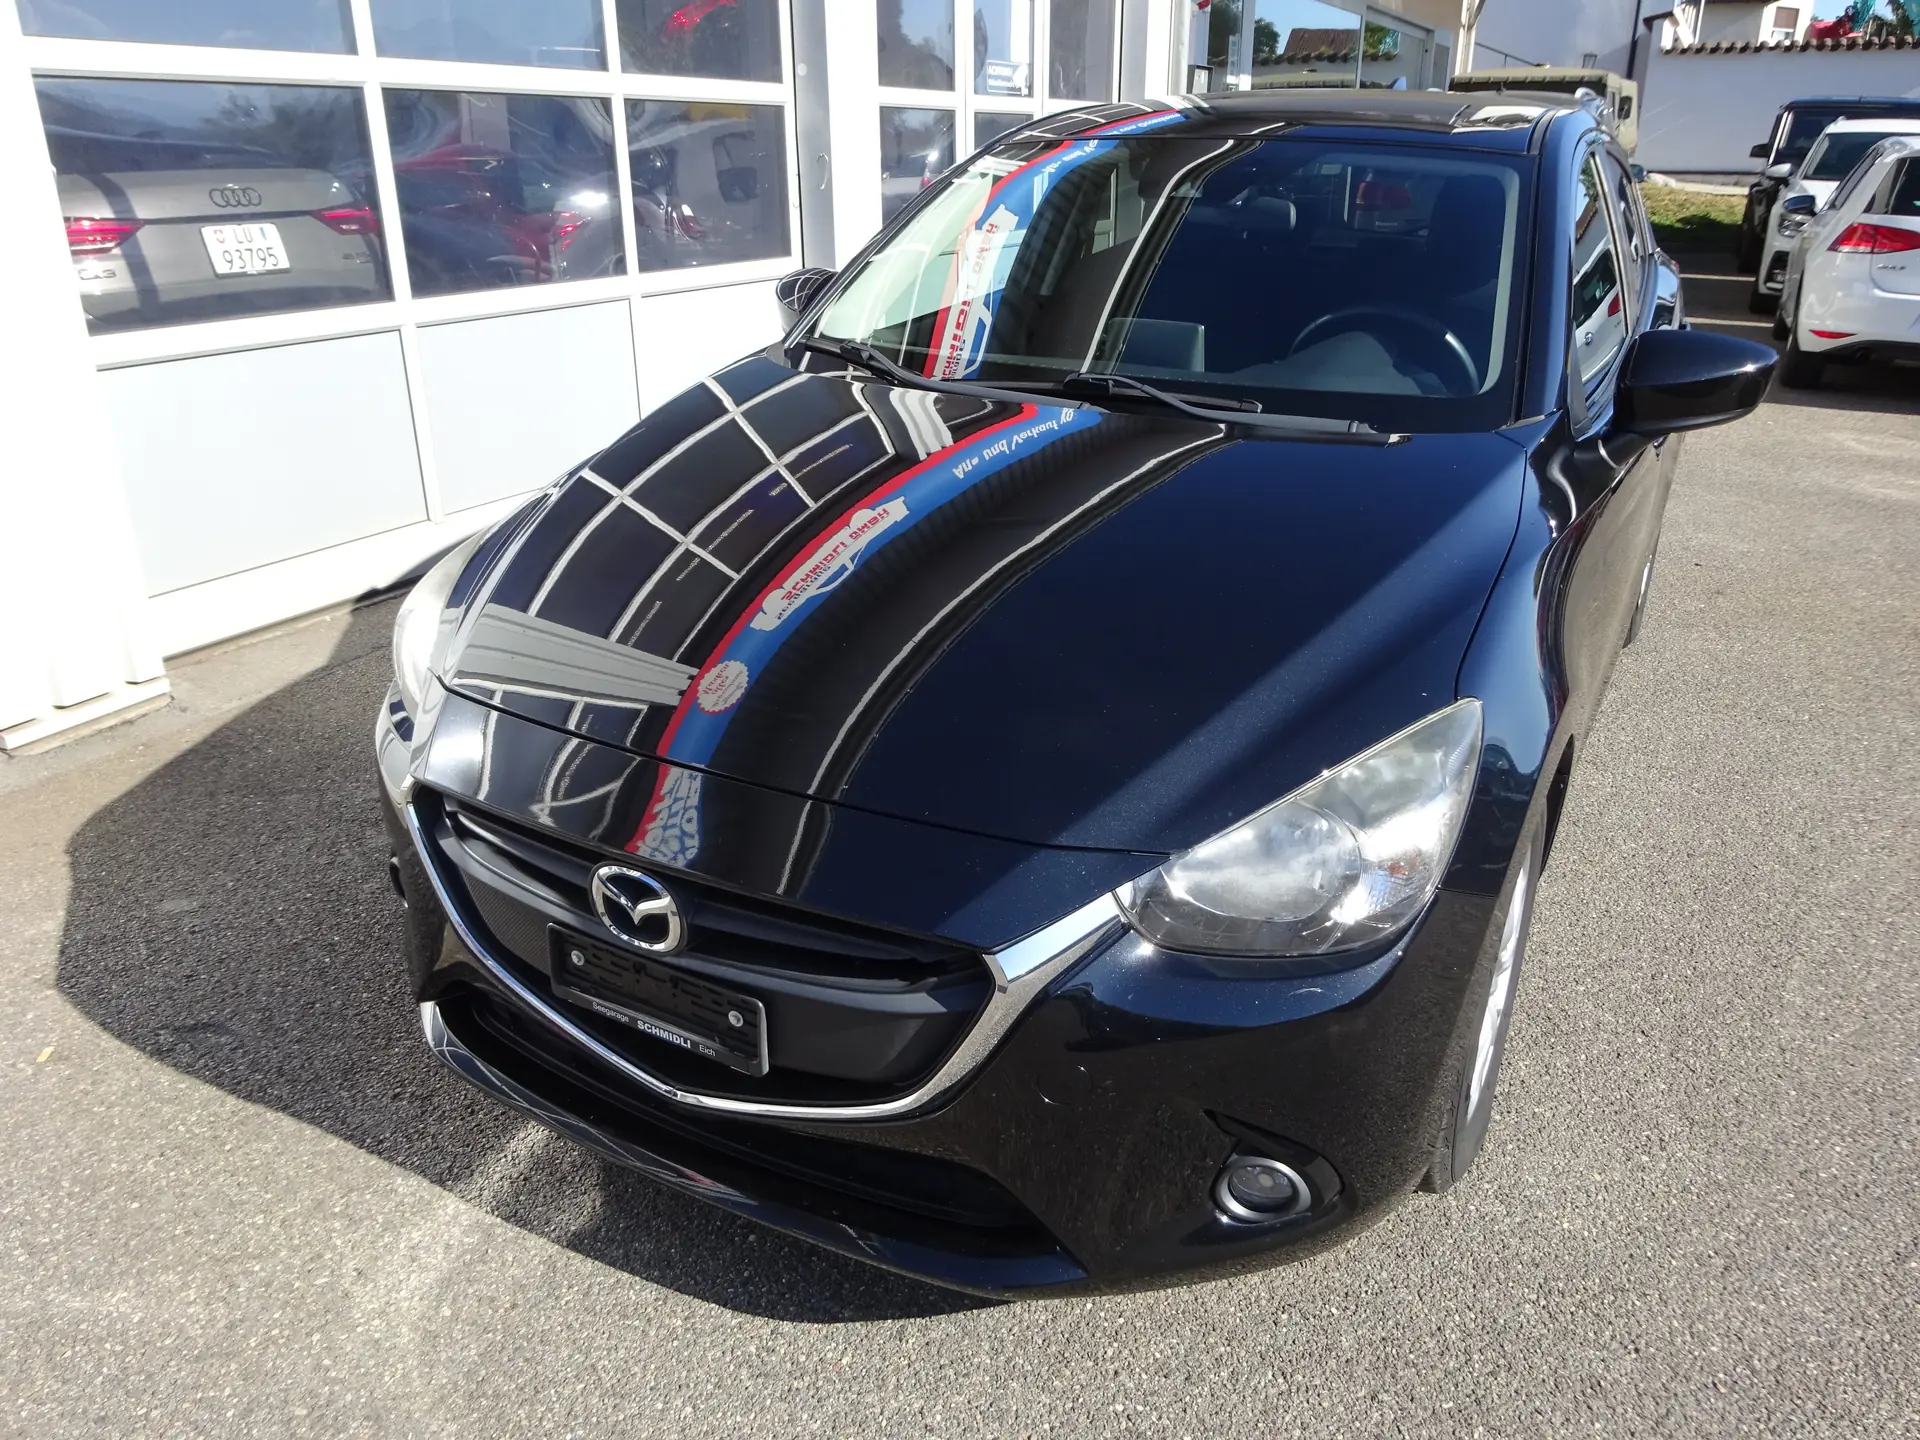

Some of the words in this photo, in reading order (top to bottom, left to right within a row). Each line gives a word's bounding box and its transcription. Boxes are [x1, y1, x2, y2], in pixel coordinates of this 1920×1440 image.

[232, 227, 254, 244] LU
[222, 246, 279, 271] 93795
[592, 1001, 630, 1024] Seegarage
[636, 1019, 692, 1049] SCHMIDLI
[698, 1044, 716, 1057] Eich
